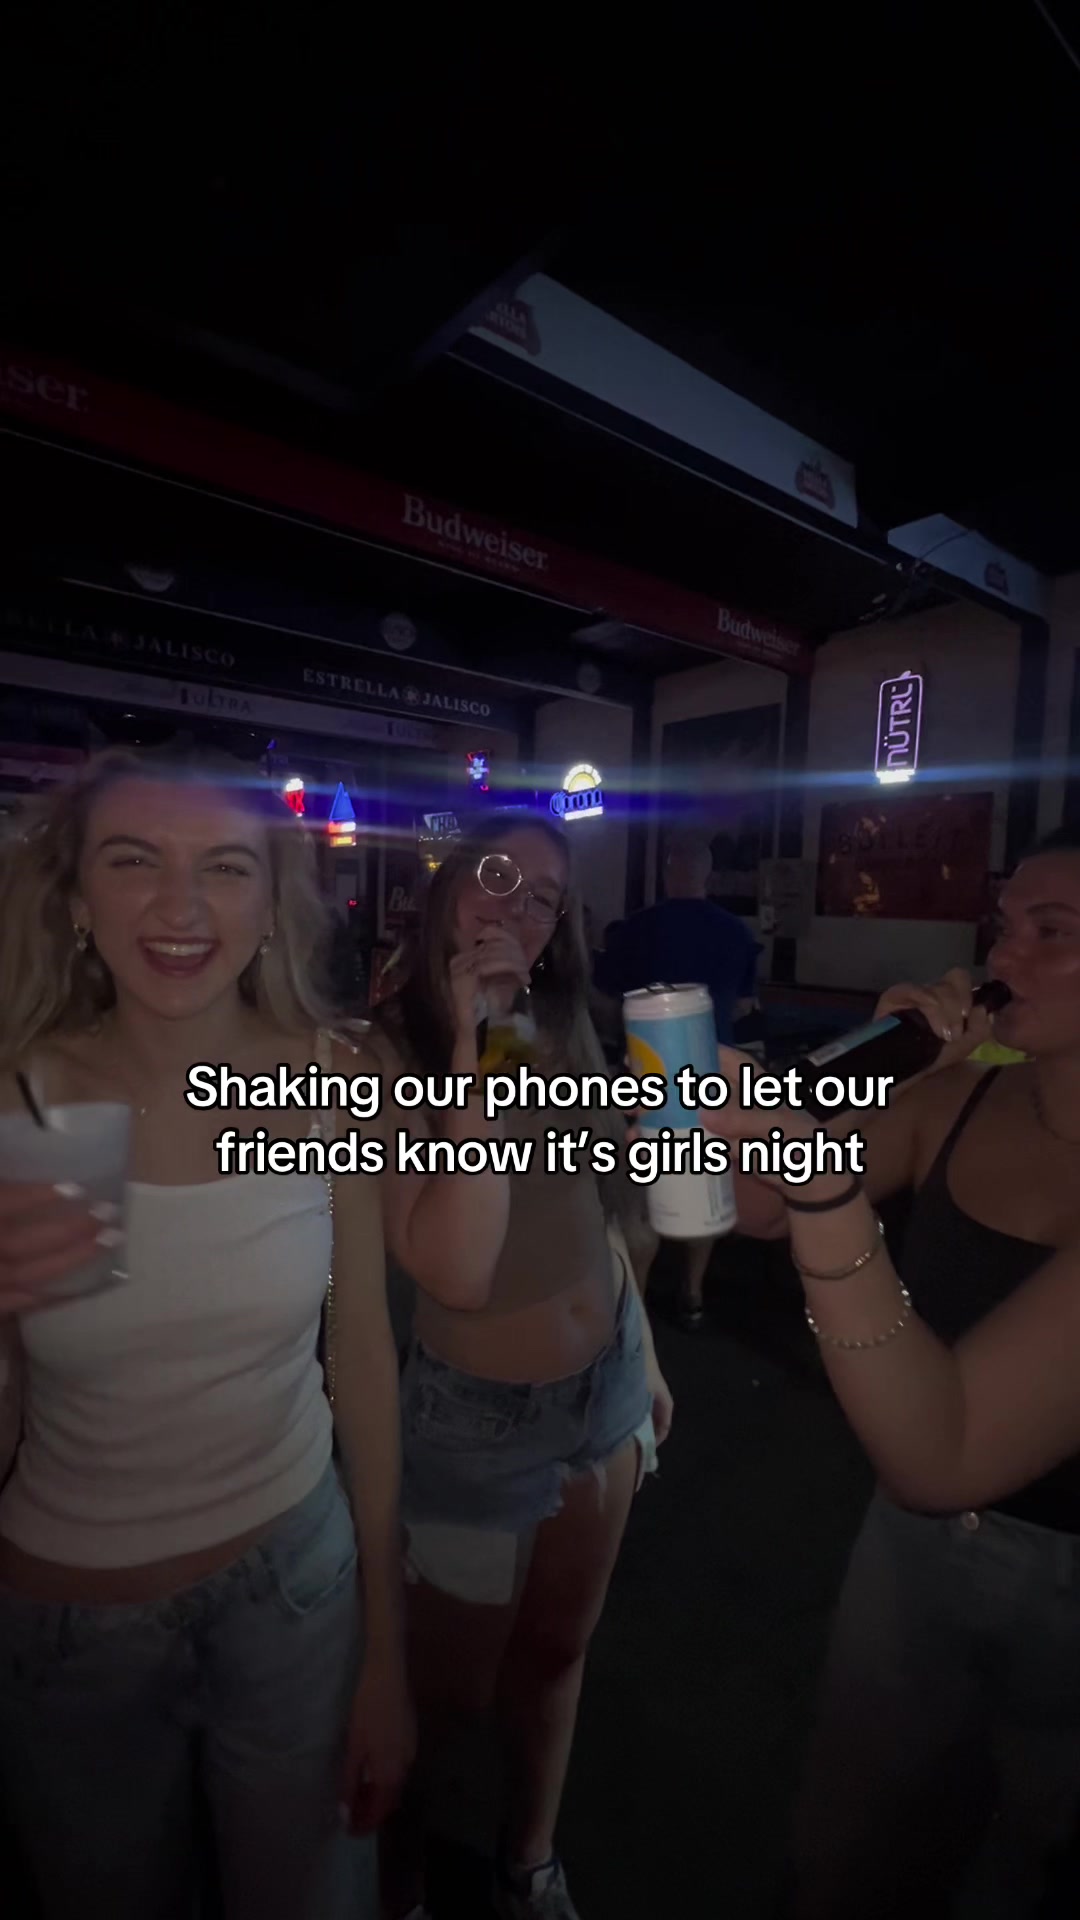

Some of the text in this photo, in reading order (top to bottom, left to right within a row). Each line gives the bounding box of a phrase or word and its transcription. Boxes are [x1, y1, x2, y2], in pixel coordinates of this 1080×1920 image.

[400, 492, 549, 570] Budweiser
[132, 633, 236, 668] JALISCO
[717, 607, 801, 657] Budweiser
[303, 668, 491, 717] ESTRELLA JALISCO
